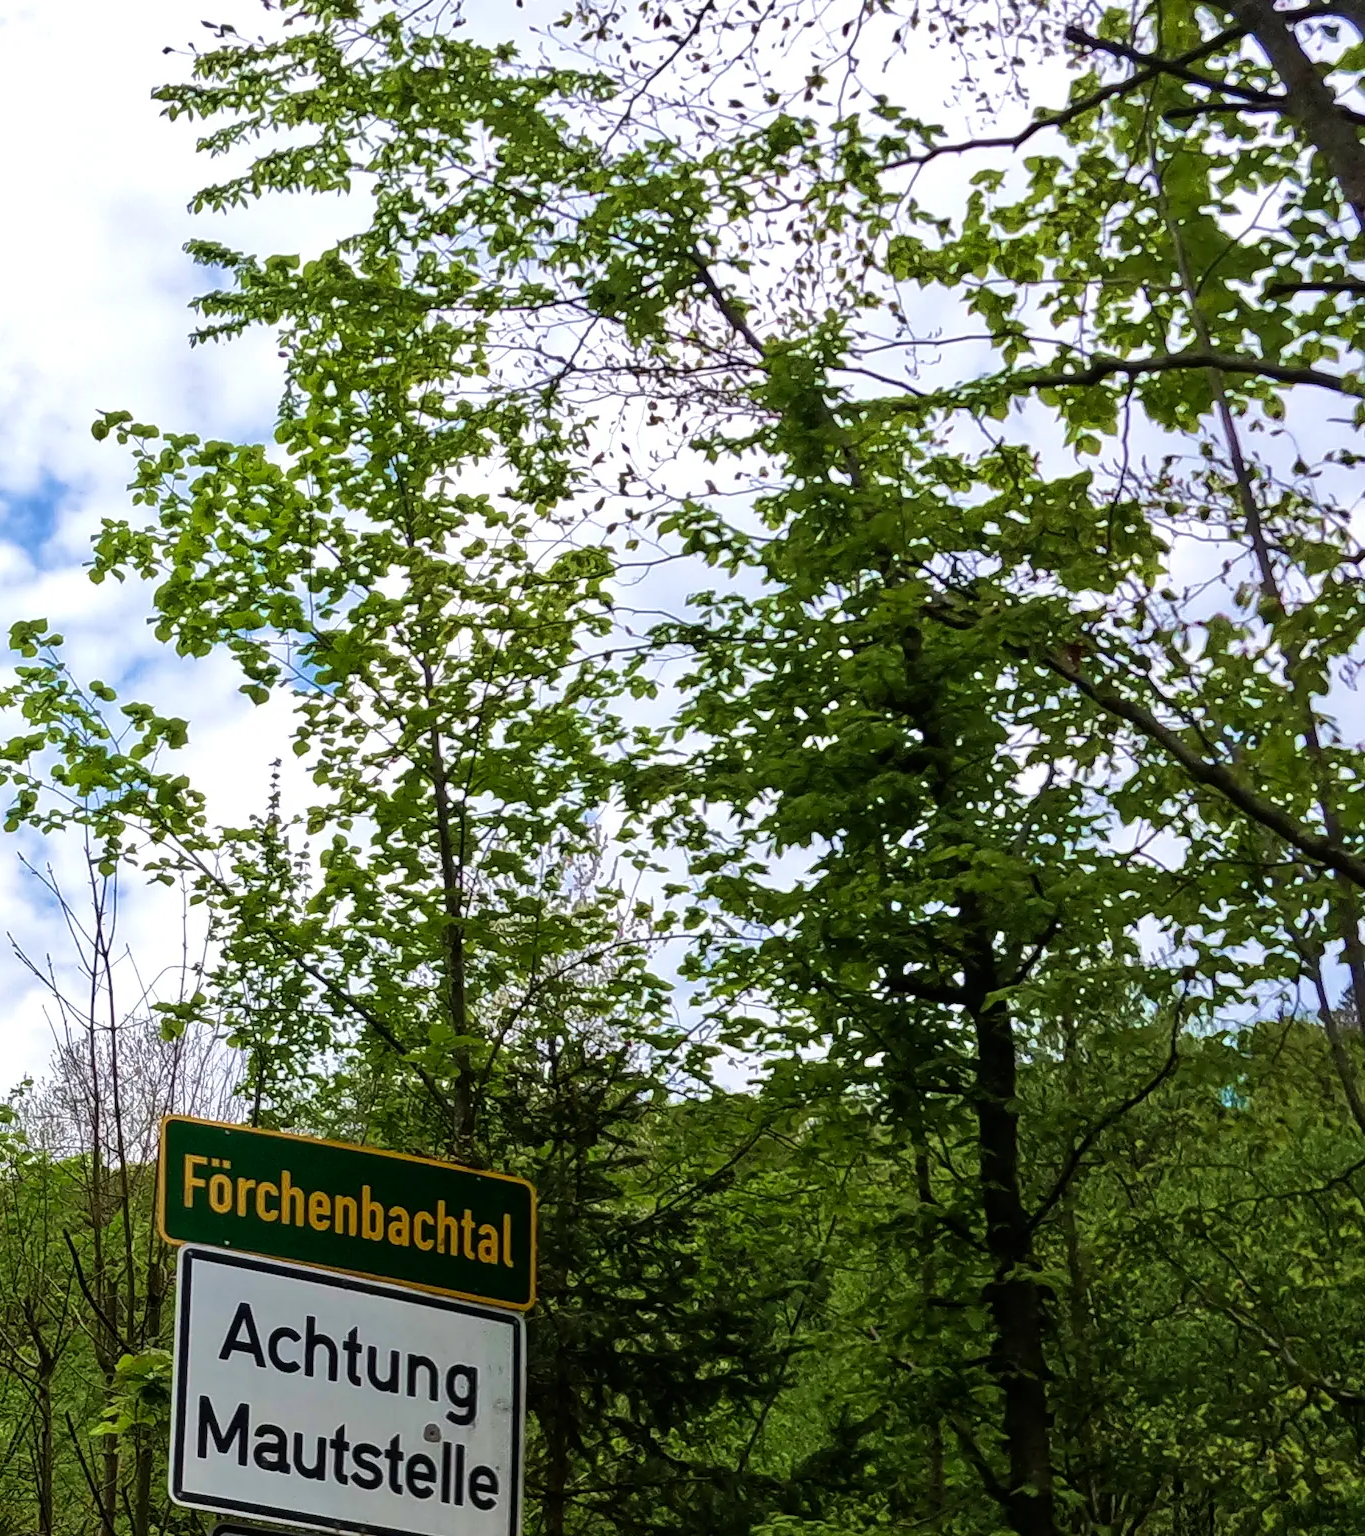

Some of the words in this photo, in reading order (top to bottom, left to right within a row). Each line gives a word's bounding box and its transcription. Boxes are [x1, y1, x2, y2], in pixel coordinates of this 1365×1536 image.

[183, 1154, 514, 1268] Förchenbachtal
[219, 1302, 478, 1426] Achtung
[197, 1395, 499, 1510] Mautstelle
